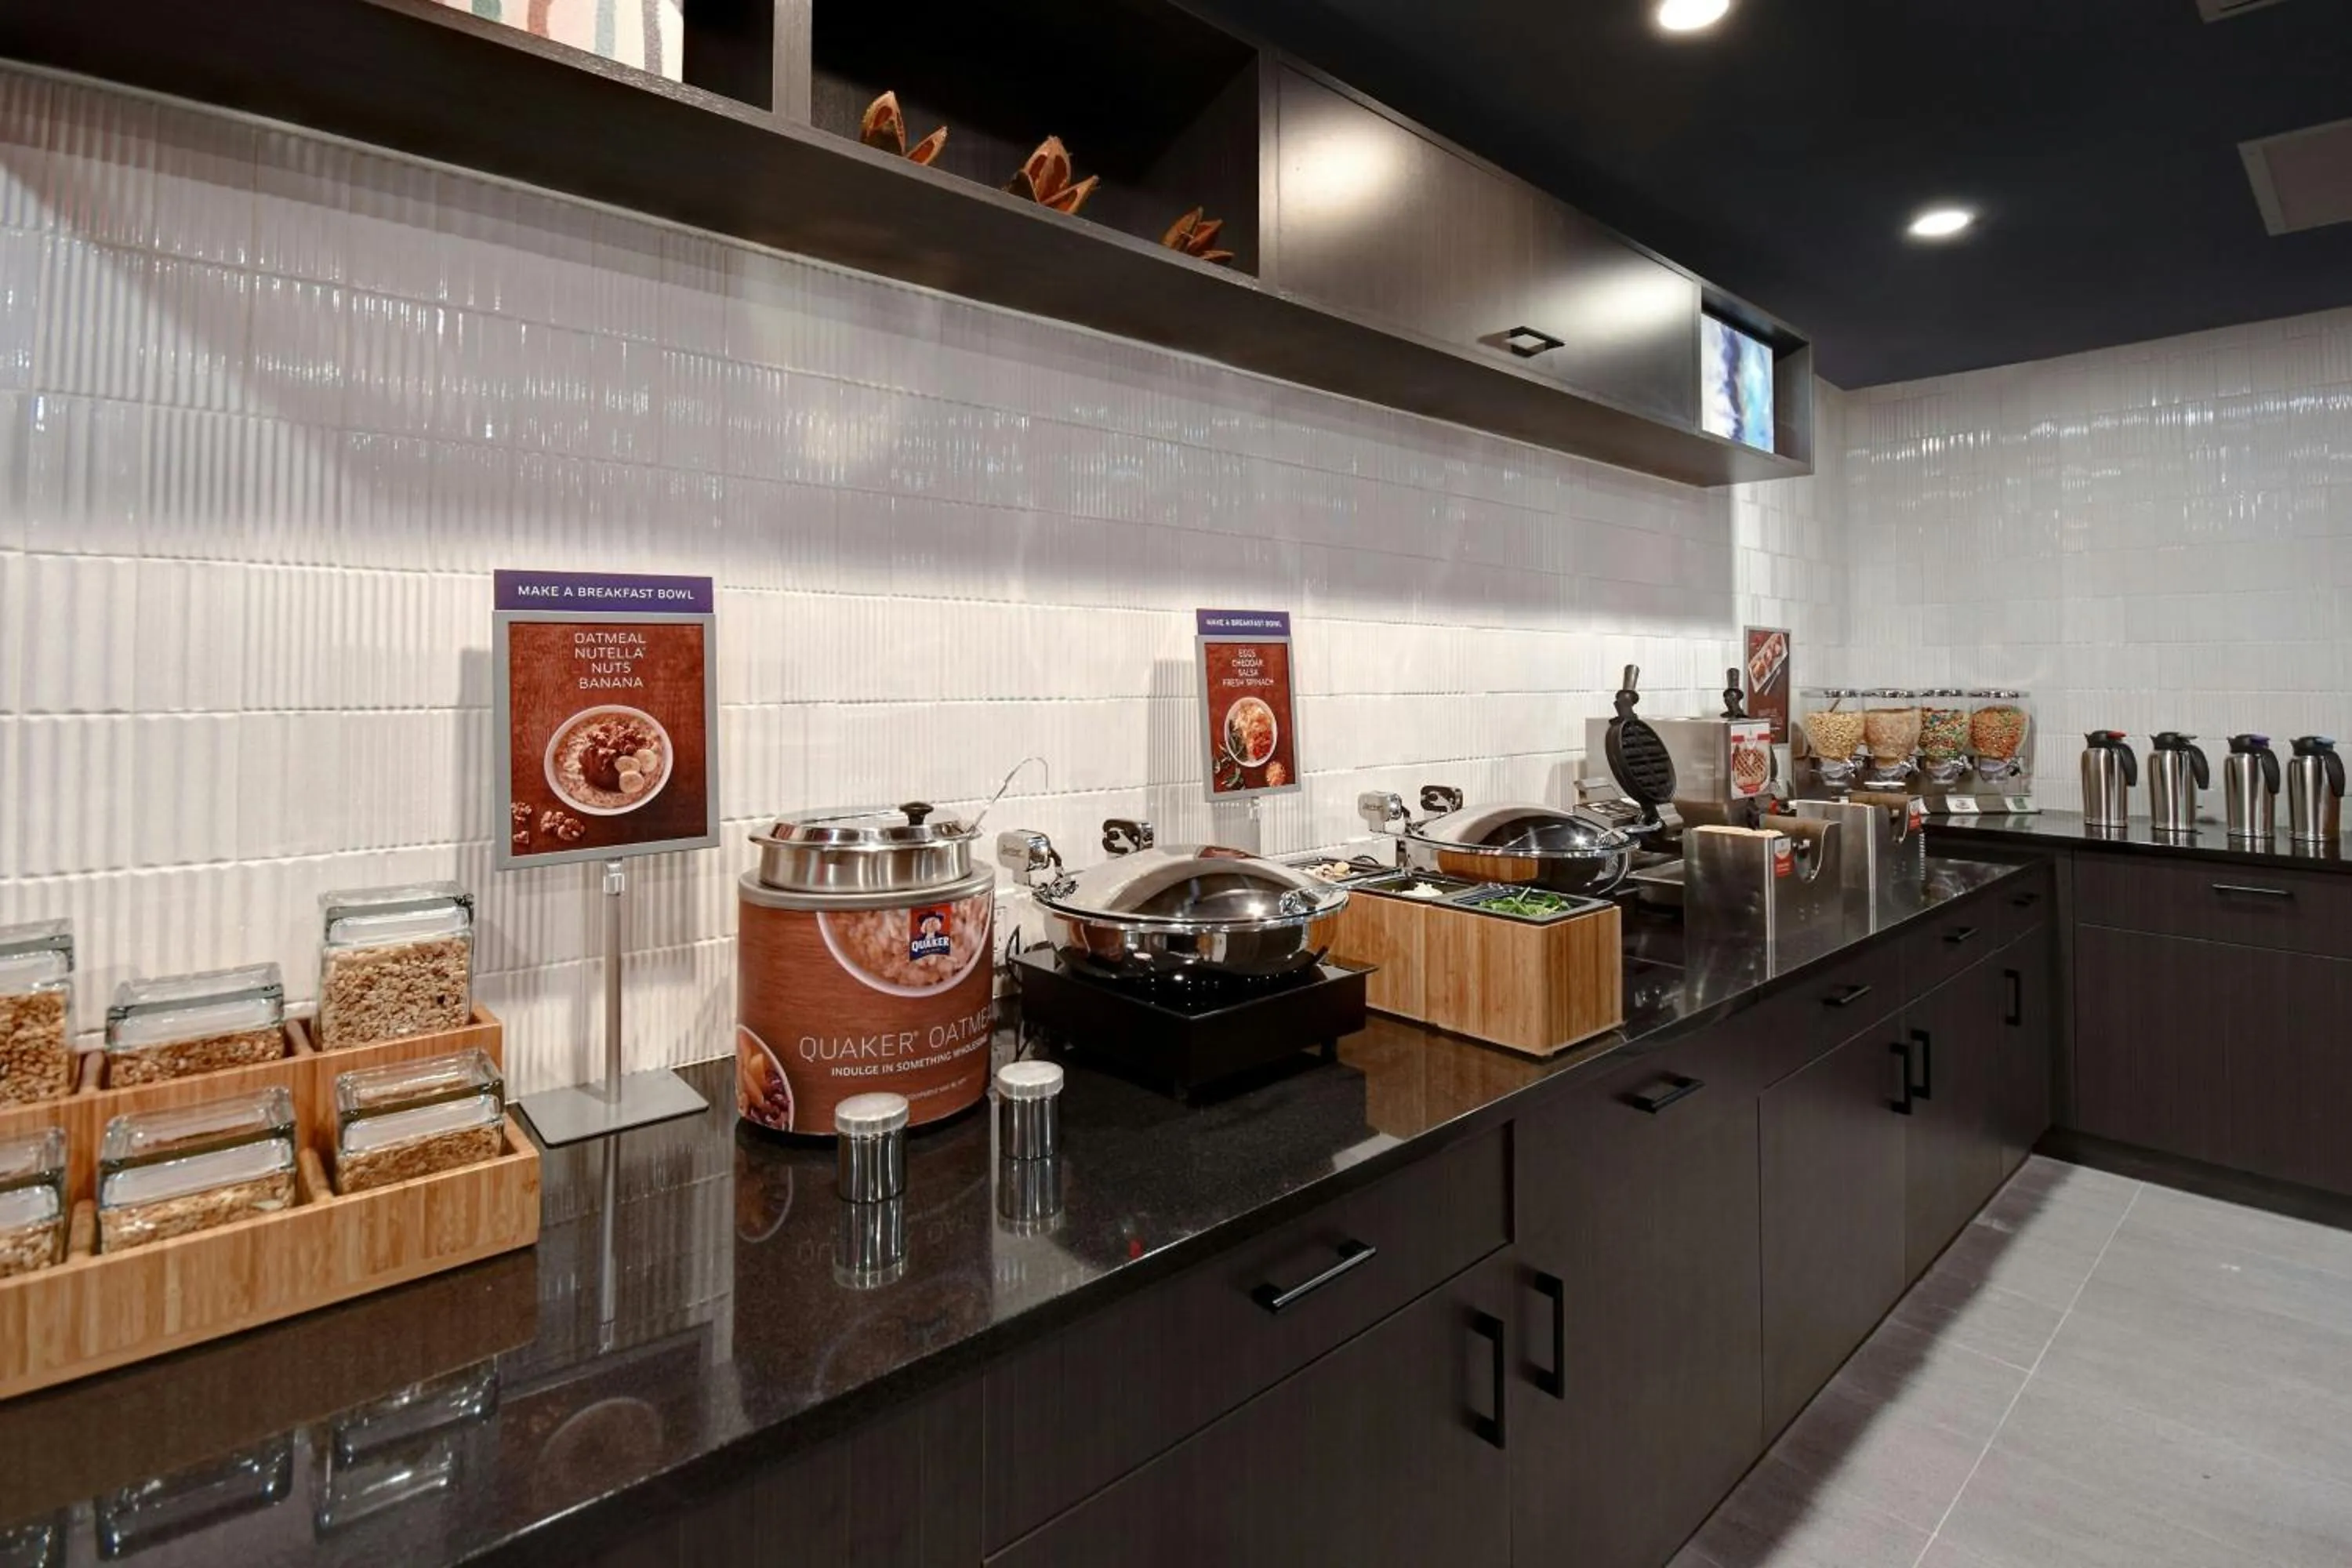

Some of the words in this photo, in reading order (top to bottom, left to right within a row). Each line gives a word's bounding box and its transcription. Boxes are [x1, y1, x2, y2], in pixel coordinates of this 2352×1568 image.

[518, 586, 559, 597] MAKE
[564, 588, 573, 597] A
[578, 587, 653, 598] BREAKFAST
[658, 589, 695, 600] BOWL
[575, 633, 647, 644] OATMEAL
[575, 647, 644, 659] NUTELLA
[591, 662, 631, 674] NUTS
[1232, 659, 1264, 667] CHEDDAR
[579, 677, 644, 689] BANANA
[1222, 678, 1244, 688] FRESH
[912, 936, 949, 953] QUAKER
[832, 1065, 879, 1077] INDULGE
[882, 1064, 894, 1073] IN
[896, 1051, 952, 1073] SOMETHING
